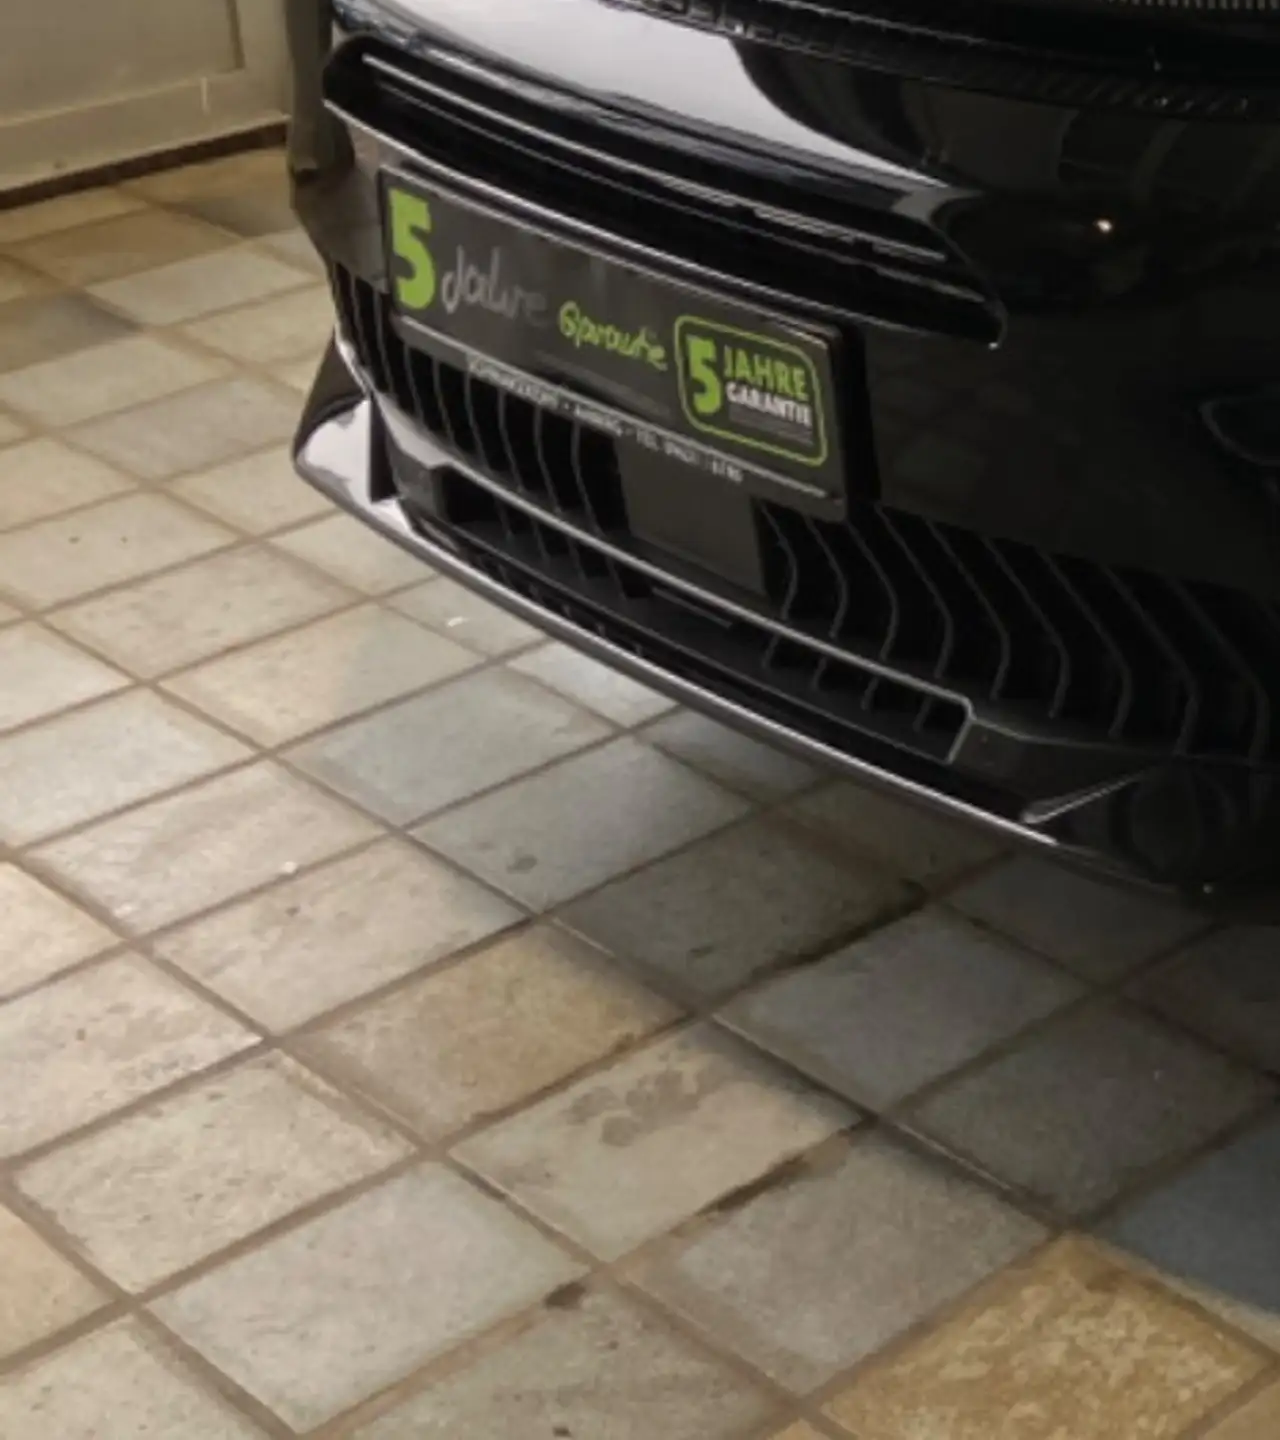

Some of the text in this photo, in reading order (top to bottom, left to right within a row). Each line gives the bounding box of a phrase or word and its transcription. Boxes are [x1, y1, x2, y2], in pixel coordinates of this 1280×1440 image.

[387, 186, 436, 309] 5
[685, 333, 722, 414] 5
[723, 344, 809, 401] JAHRE
